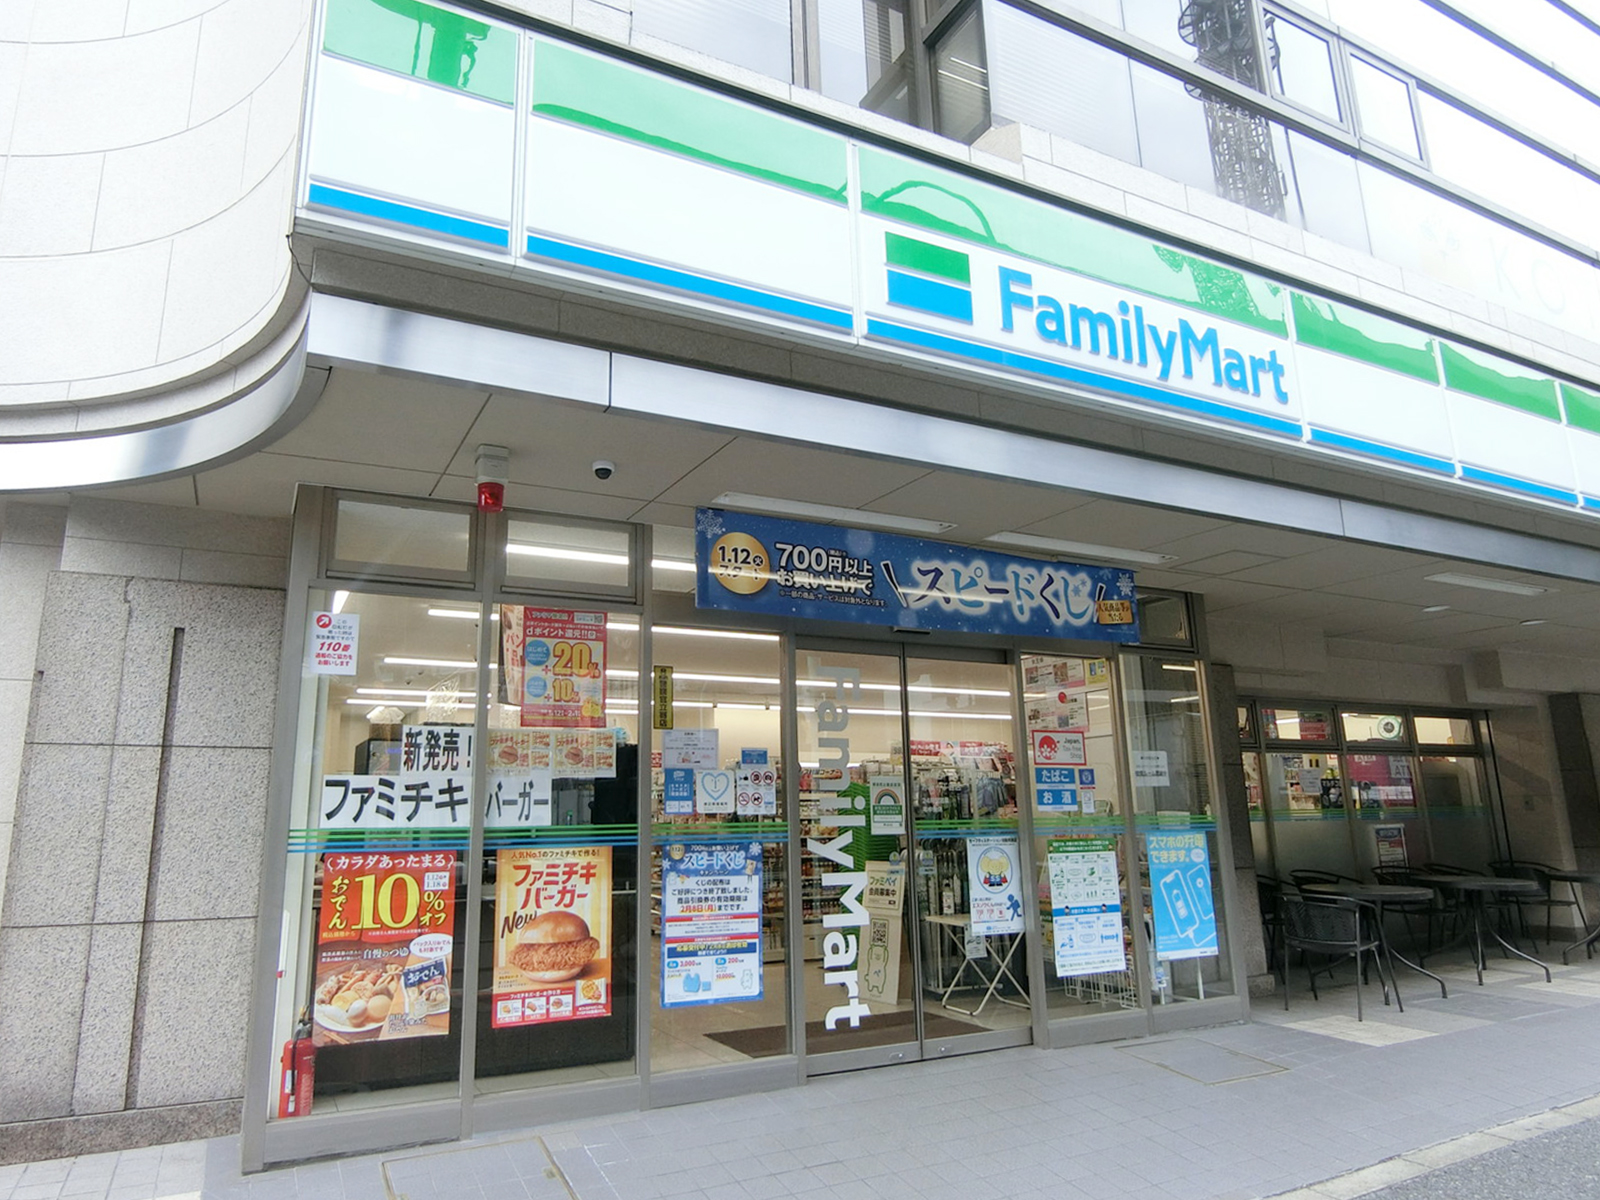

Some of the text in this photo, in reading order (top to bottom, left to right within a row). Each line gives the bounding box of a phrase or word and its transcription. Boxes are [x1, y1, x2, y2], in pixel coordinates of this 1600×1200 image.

[998, 264, 1288, 405] FamilyMart
[774, 542, 874, 578] 700円以上
[912, 562, 1091, 623] スピードくじ
[319, 641, 352, 652] 110番
[403, 727, 473, 771] 新発売!
[1041, 770, 1070, 782] たばこ
[325, 777, 549, 823] ファミチキ バーガー
[807, 666, 871, 1031] FamilyMart
[1149, 834, 1205, 849] スマホの充電
[336, 854, 446, 870] カラダあったまる
[511, 849, 600, 859] 人気No.1のファミチキで作る!
[681, 851, 746, 869] スピードくじ
[1150, 850, 1190, 864] できます。
[512, 861, 598, 887] ファミチキ
[869, 876, 898, 887] ファミペイ
[327, 875, 350, 930] おでん
[520, 884, 589, 910] バーガー
[420, 912, 447, 927] オフ
[500, 910, 538, 939] New
[407, 966, 441, 983] おでん
